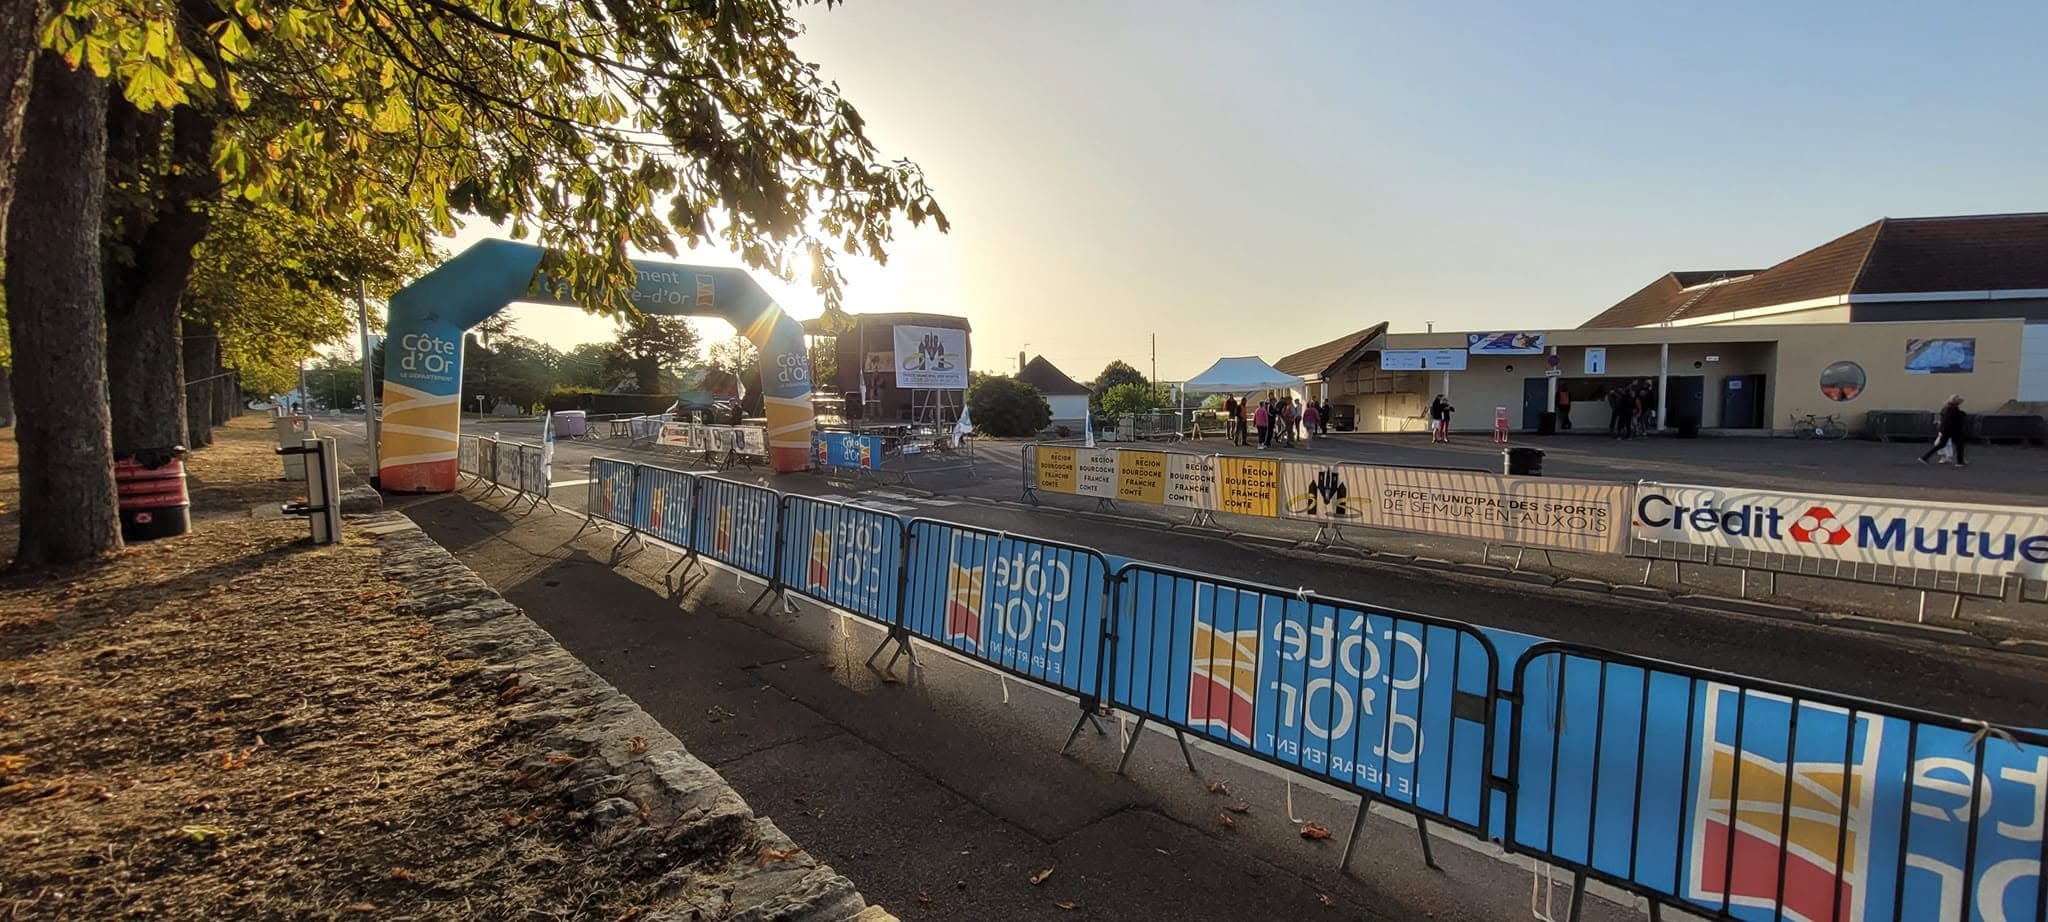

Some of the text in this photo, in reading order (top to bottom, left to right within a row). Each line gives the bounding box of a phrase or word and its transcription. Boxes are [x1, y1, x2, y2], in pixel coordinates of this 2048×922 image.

[402, 332, 455, 355] Côte
[401, 351, 454, 374] d'Or
[776, 352, 807, 367] Côte
[1041, 462, 1072, 471] BOURGOGNE
[1080, 465, 1115, 474] BOURGOGNE
[1045, 471, 1069, 479] FRANCHE
[1122, 468, 1162, 478] BOURGOGNE
[1170, 472, 1216, 484] BOURGOGNE
[1084, 475, 1109, 483] FRANCHE
[1126, 479, 1156, 488] FRANCHE
[1225, 477, 1277, 489] BOURGOGNE
[1174, 483, 1209, 494] FRANCHE
[1231, 489, 1270, 500] FRANCHE
[1384, 489, 1607, 517] OFFICE MUNICIPAL DES SPORTS
[1383, 498, 1607, 533] DE SEMUR-EN-AUXOIS
[1637, 493, 1784, 541] Crédit
